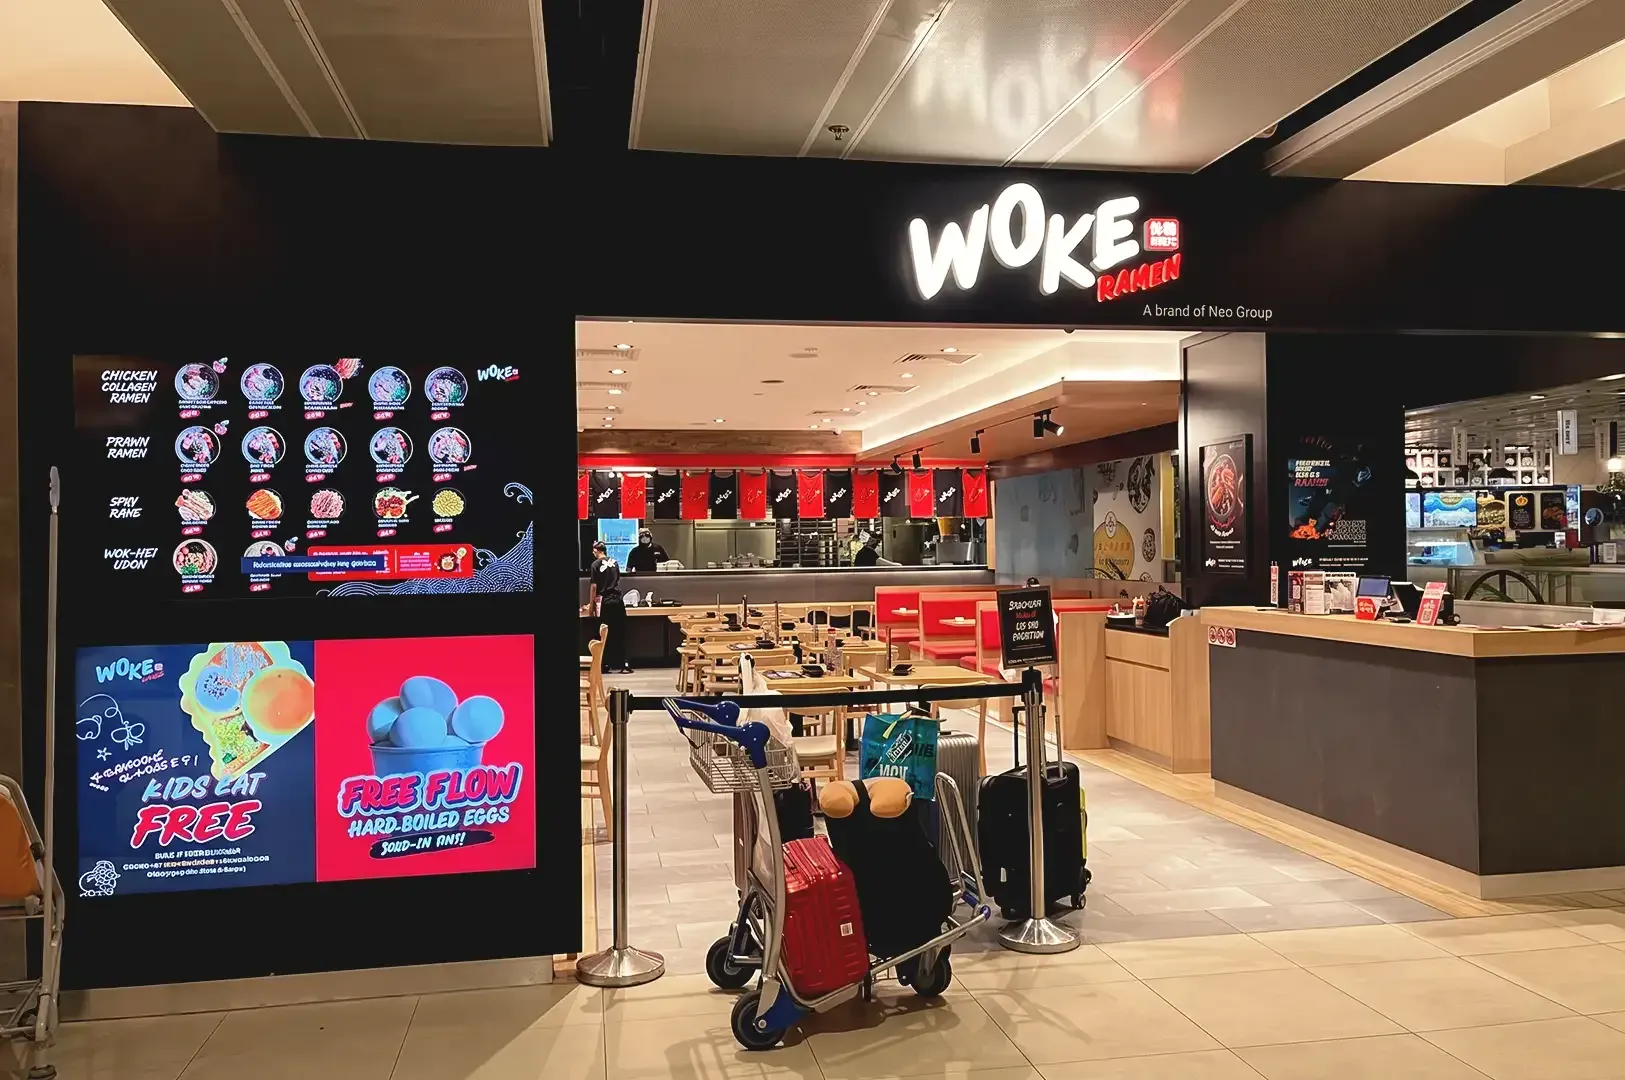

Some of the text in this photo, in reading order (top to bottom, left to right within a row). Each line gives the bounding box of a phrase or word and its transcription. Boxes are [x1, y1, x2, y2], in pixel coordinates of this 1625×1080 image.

[909, 182, 1140, 300] WOKE
[1097, 253, 1181, 302] RAMEN
[1143, 304, 1273, 321] A brand of Neo Group
[101, 370, 158, 381] CHICKEN
[477, 364, 513, 381] WOKE
[101, 382, 157, 392] COLLAGEN
[109, 393, 151, 403] RAMEN
[106, 436, 150, 447] PRAWN
[107, 448, 148, 458] RAMEN
[104, 547, 159, 559] WOK-HEI
[113, 559, 148, 570] UDON
[96, 657, 154, 683] WOKE
[142, 772, 267, 803] KIDS EAT
[338, 762, 523, 817] FREE FLOW
[130, 800, 262, 849] FREE
[348, 806, 510, 838] HARD-BOILED EGGS
